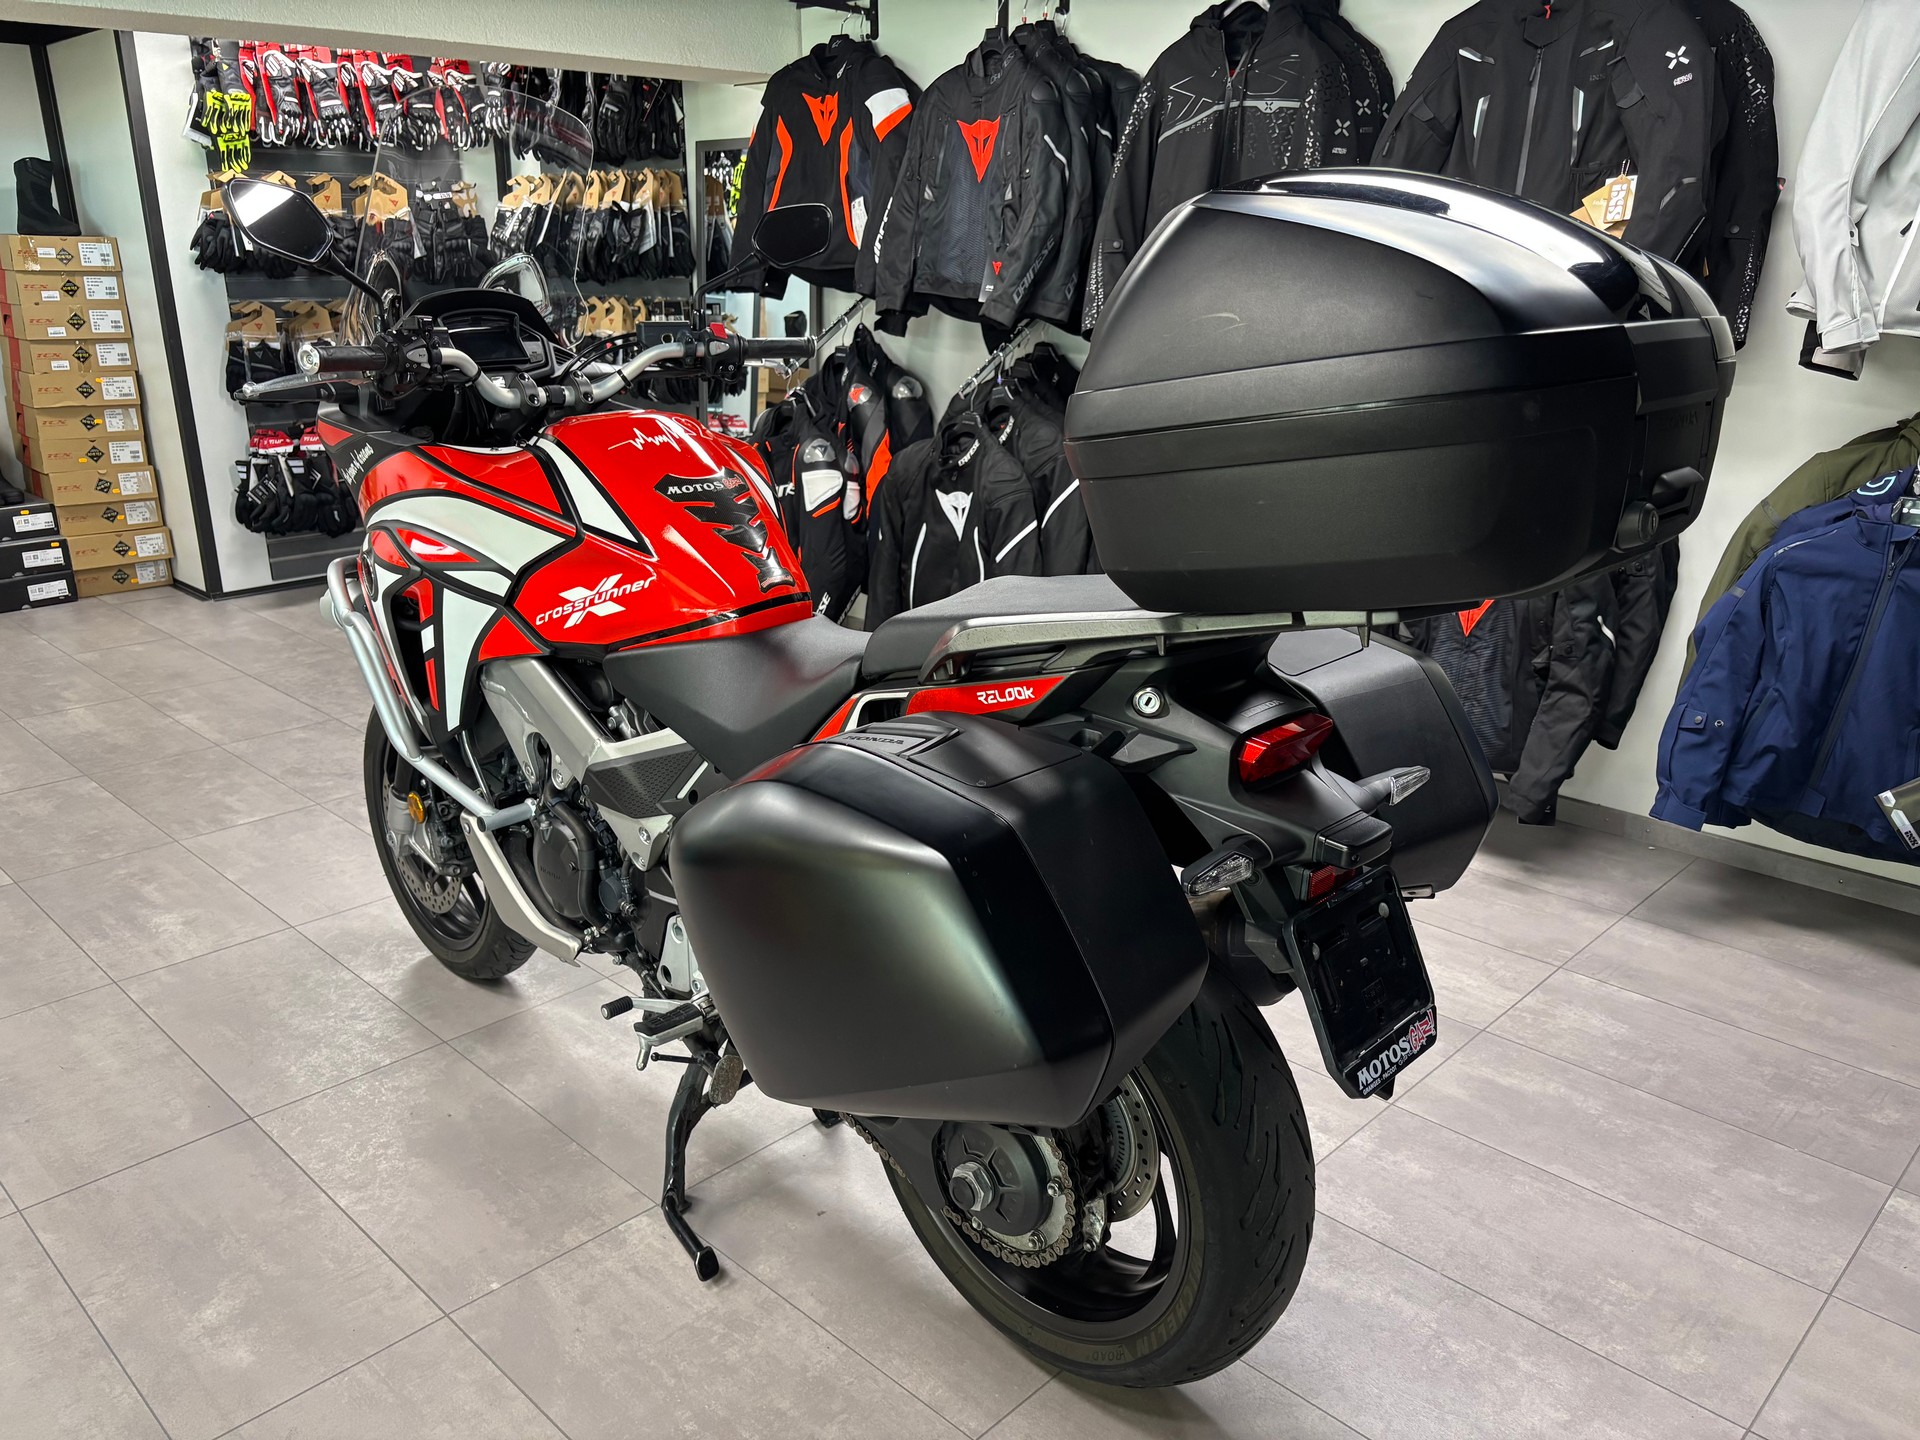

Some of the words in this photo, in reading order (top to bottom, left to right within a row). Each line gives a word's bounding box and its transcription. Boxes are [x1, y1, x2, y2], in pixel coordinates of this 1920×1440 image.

[1012, 234, 1055, 305] DAINESE
[667, 481, 724, 495] MOTOS
[535, 576, 657, 626] crossrunner
[976, 686, 1036, 705] RELOOK
[1357, 1037, 1411, 1091] MOTOS
